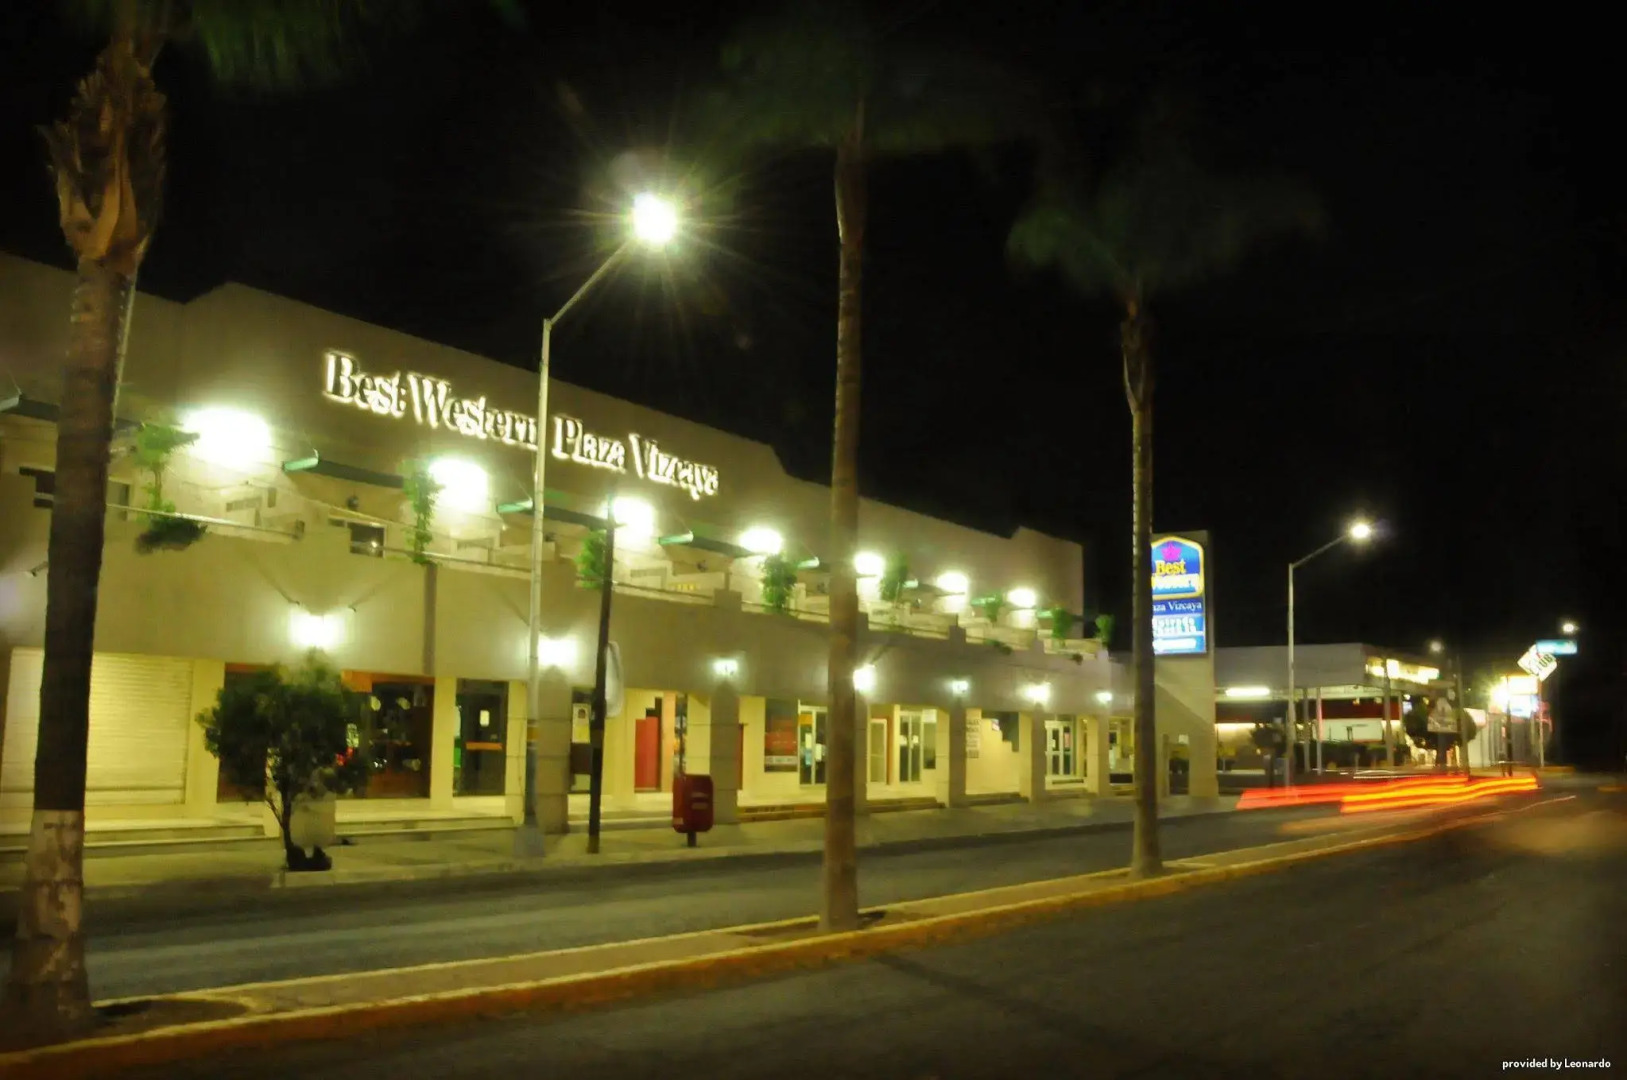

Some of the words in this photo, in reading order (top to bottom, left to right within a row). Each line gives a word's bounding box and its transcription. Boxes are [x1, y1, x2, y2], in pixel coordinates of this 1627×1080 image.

[323, 351, 405, 417] Best
[407, 372, 540, 450] Western
[551, 413, 627, 473] Plaza
[629, 432, 719, 500] Vizcaya
[1155, 559, 1186, 576] Best
[1168, 601, 1202, 613] Vizcaya
